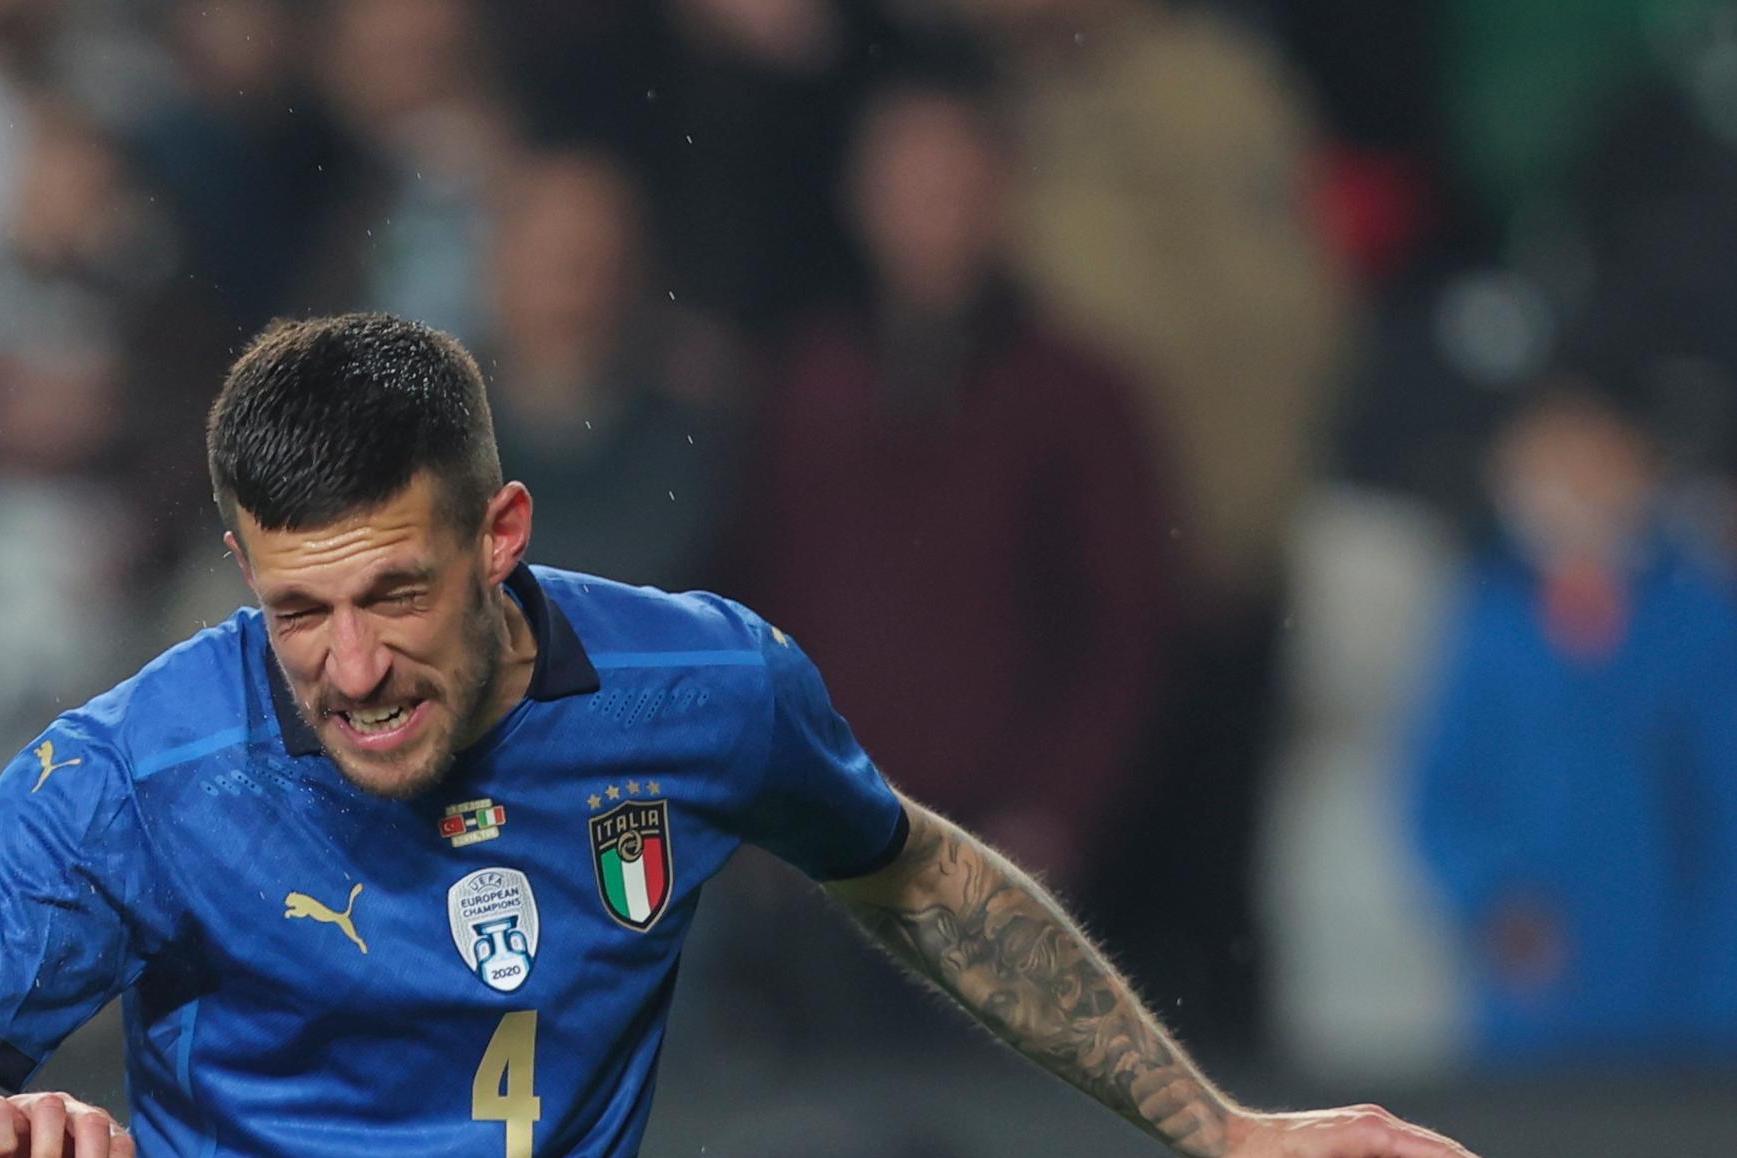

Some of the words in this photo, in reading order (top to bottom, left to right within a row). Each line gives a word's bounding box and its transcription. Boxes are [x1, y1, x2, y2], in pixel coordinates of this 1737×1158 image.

[596, 809, 660, 842] ITALIA
[469, 874, 503, 892] UEFA
[461, 887, 519, 908] EUROPEAN
[463, 897, 521, 918] CHAMPIONS
[491, 965, 521, 980] 2020
